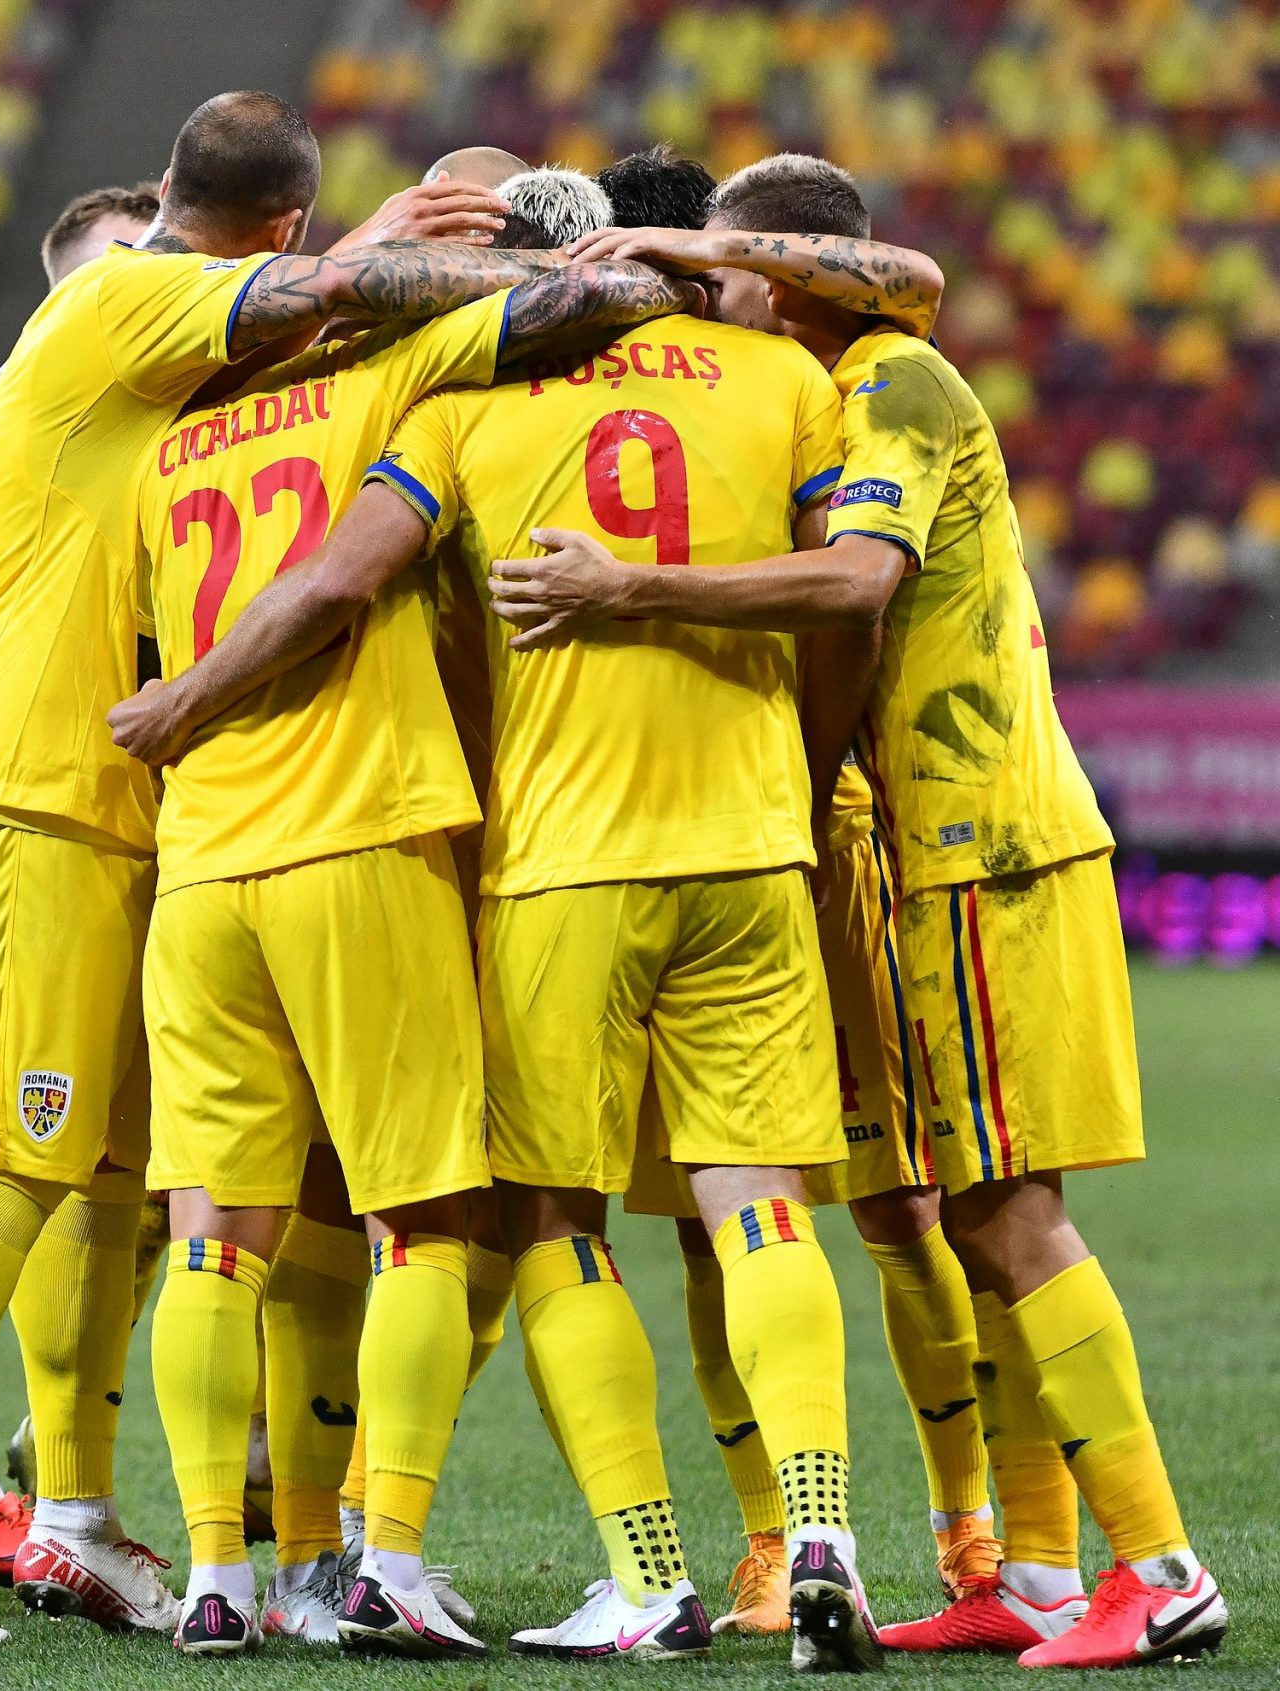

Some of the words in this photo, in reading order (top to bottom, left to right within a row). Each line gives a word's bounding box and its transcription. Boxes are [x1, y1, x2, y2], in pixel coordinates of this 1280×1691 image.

[585, 409, 690, 565] 9
[846, 484, 902, 501] RESPECT
[170, 456, 330, 664] 22
[24, 1072, 68, 1090] ROMÂNIA
[843, 1121, 885, 1143] ma
[23, 1547, 49, 1568] 7
